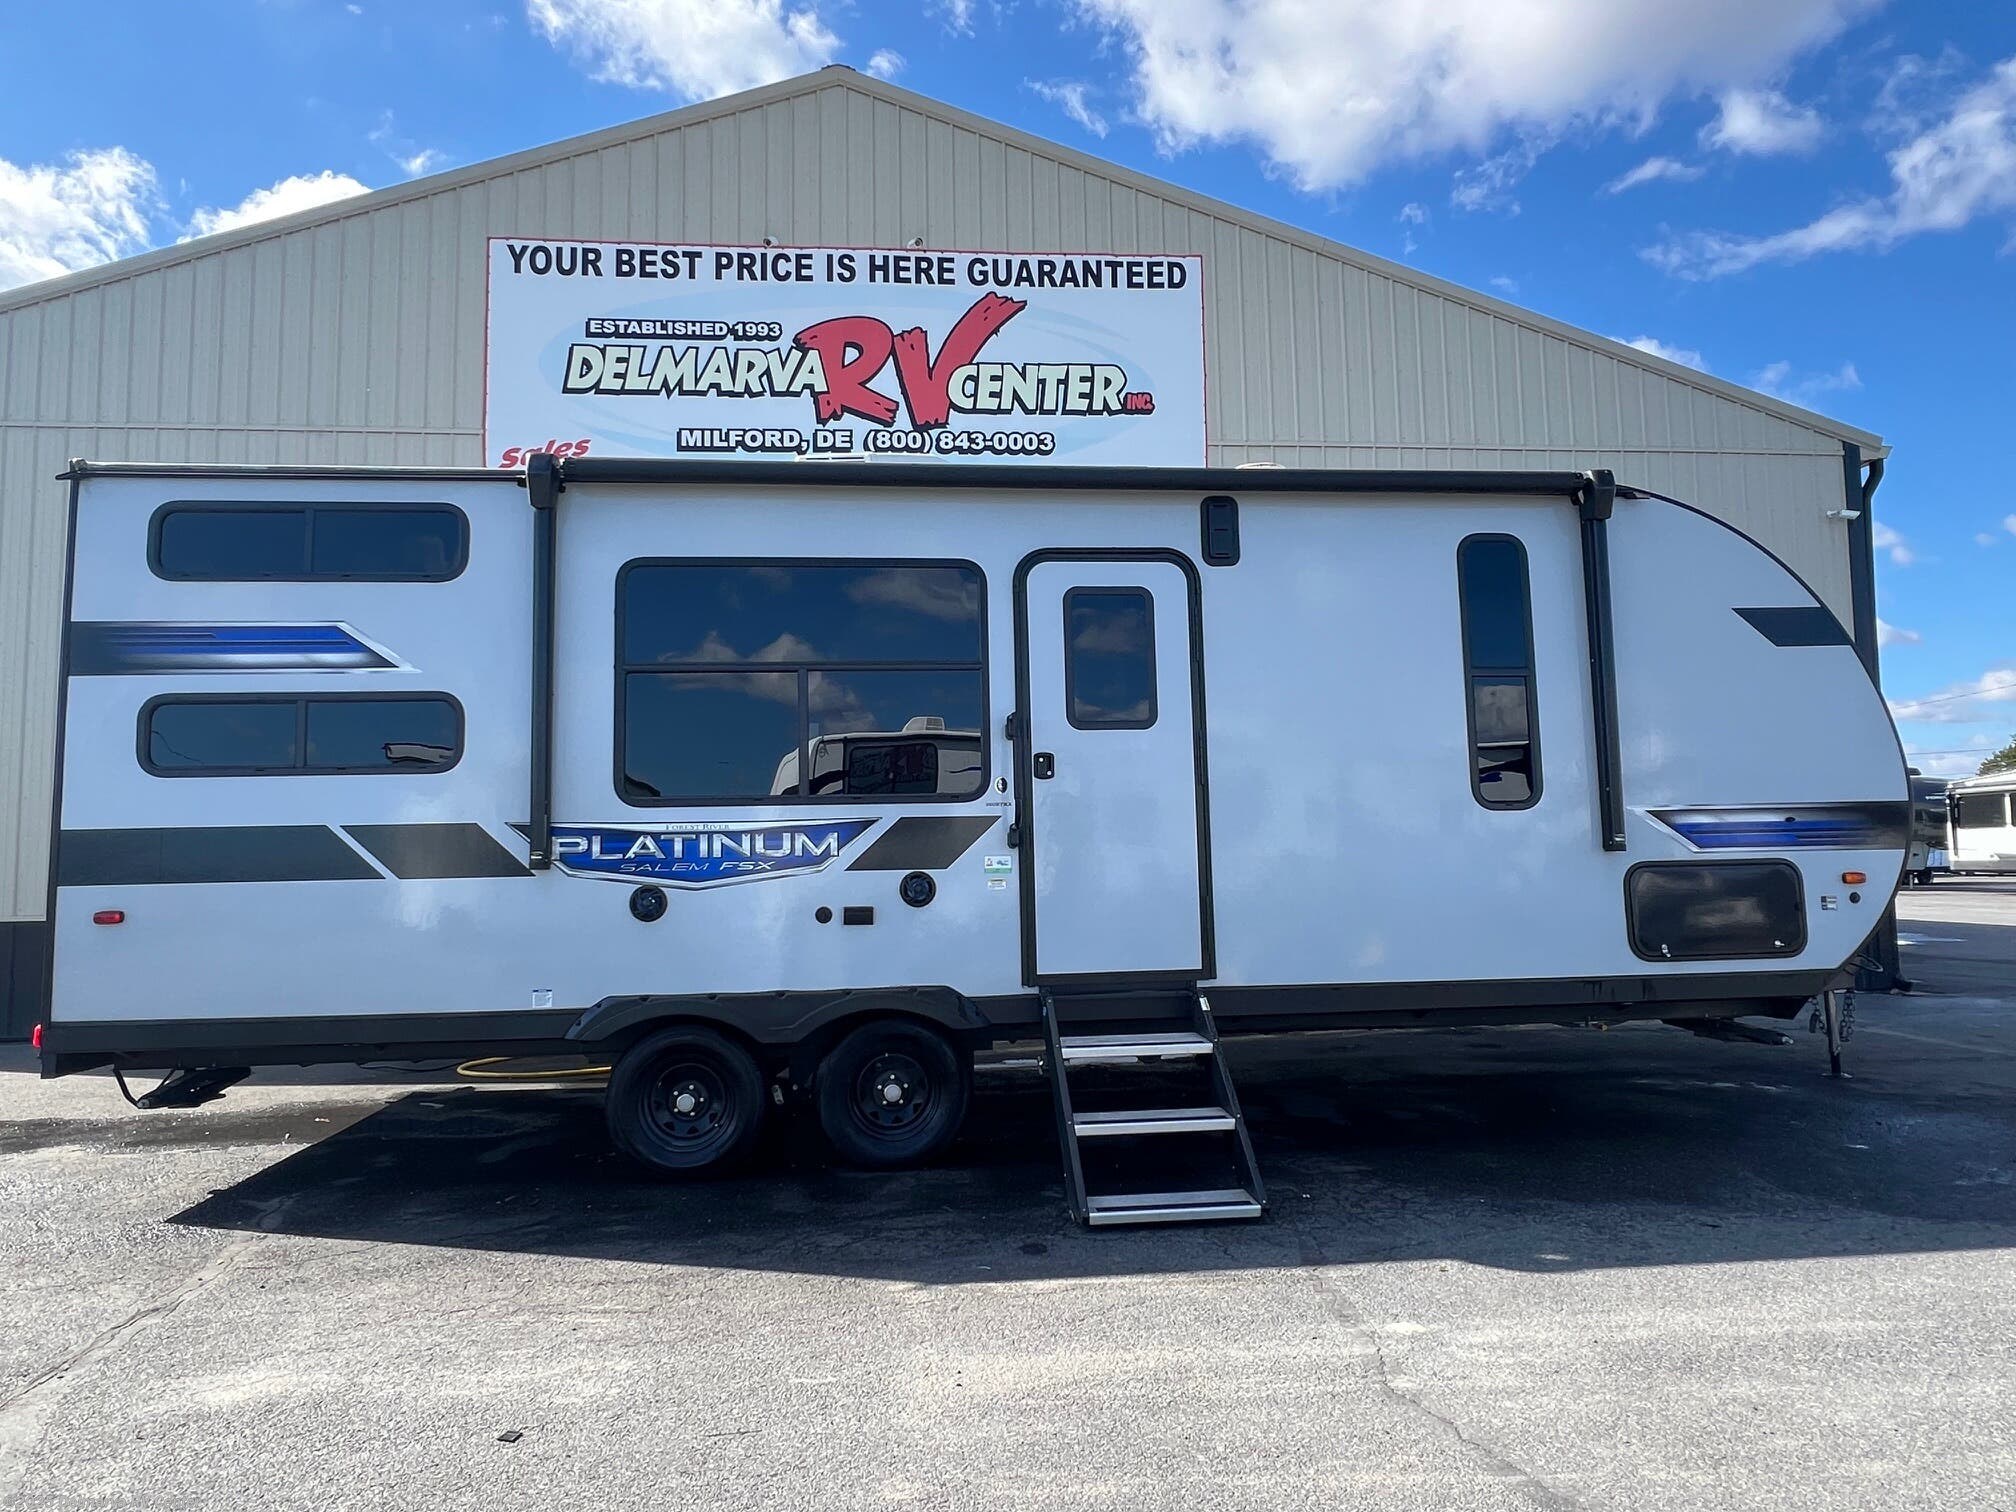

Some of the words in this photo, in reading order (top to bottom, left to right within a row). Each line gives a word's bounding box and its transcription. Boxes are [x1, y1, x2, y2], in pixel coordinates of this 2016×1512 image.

[506, 244, 603, 277] YOUR
[615, 248, 702, 280] BEST
[714, 251, 813, 282] PRICE
[826, 254, 856, 283] IS
[868, 255, 956, 285] HERE
[967, 258, 1186, 290] GUARANTEED
[588, 319, 728, 338] ESTABLISHED
[733, 322, 782, 338] 1993
[564, 344, 830, 396] DELMARVA
[795, 291, 1028, 430] RV
[948, 362, 1126, 413] CENTER
[679, 428, 809, 450] MILFORD,
[815, 431, 853, 449] DE
[866, 431, 932, 453] (800)
[938, 432, 1055, 452] 843-0003
[552, 832, 840, 860] PLATINUM
[618, 861, 709, 873] SALEM
[718, 860, 777, 872] FSX
